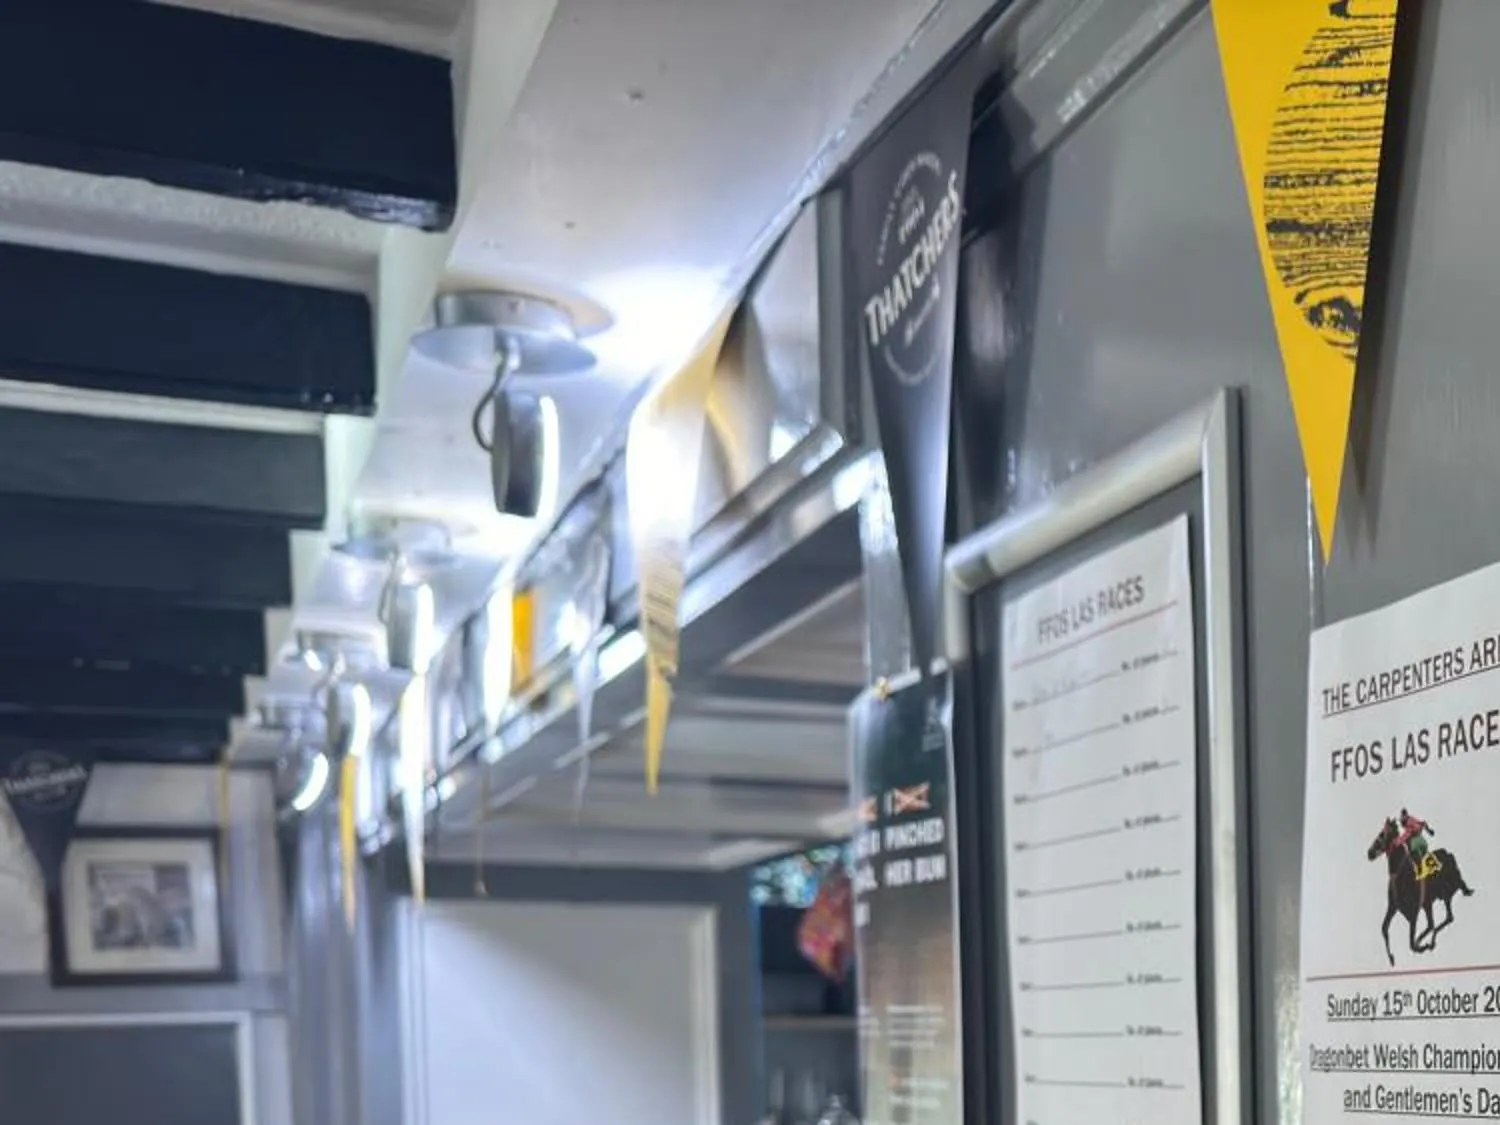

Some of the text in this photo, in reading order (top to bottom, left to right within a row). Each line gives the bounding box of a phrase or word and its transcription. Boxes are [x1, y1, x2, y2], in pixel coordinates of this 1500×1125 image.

[1097, 575, 1144, 616] RACES
[1322, 682, 1351, 713] THE
[1355, 647, 1465, 705] CARPENTERS
[1331, 741, 1383, 783] FFOS
[1391, 729, 1430, 771] LAS
[1327, 993, 1378, 1021] Sunday
[1383, 990, 1413, 1015] 15th
[1417, 988, 1479, 1014] October
[1373, 1043, 1419, 1069] Welsh
[1343, 1084, 1371, 1108] and
[1375, 1084, 1473, 1113] Gentlemen's
